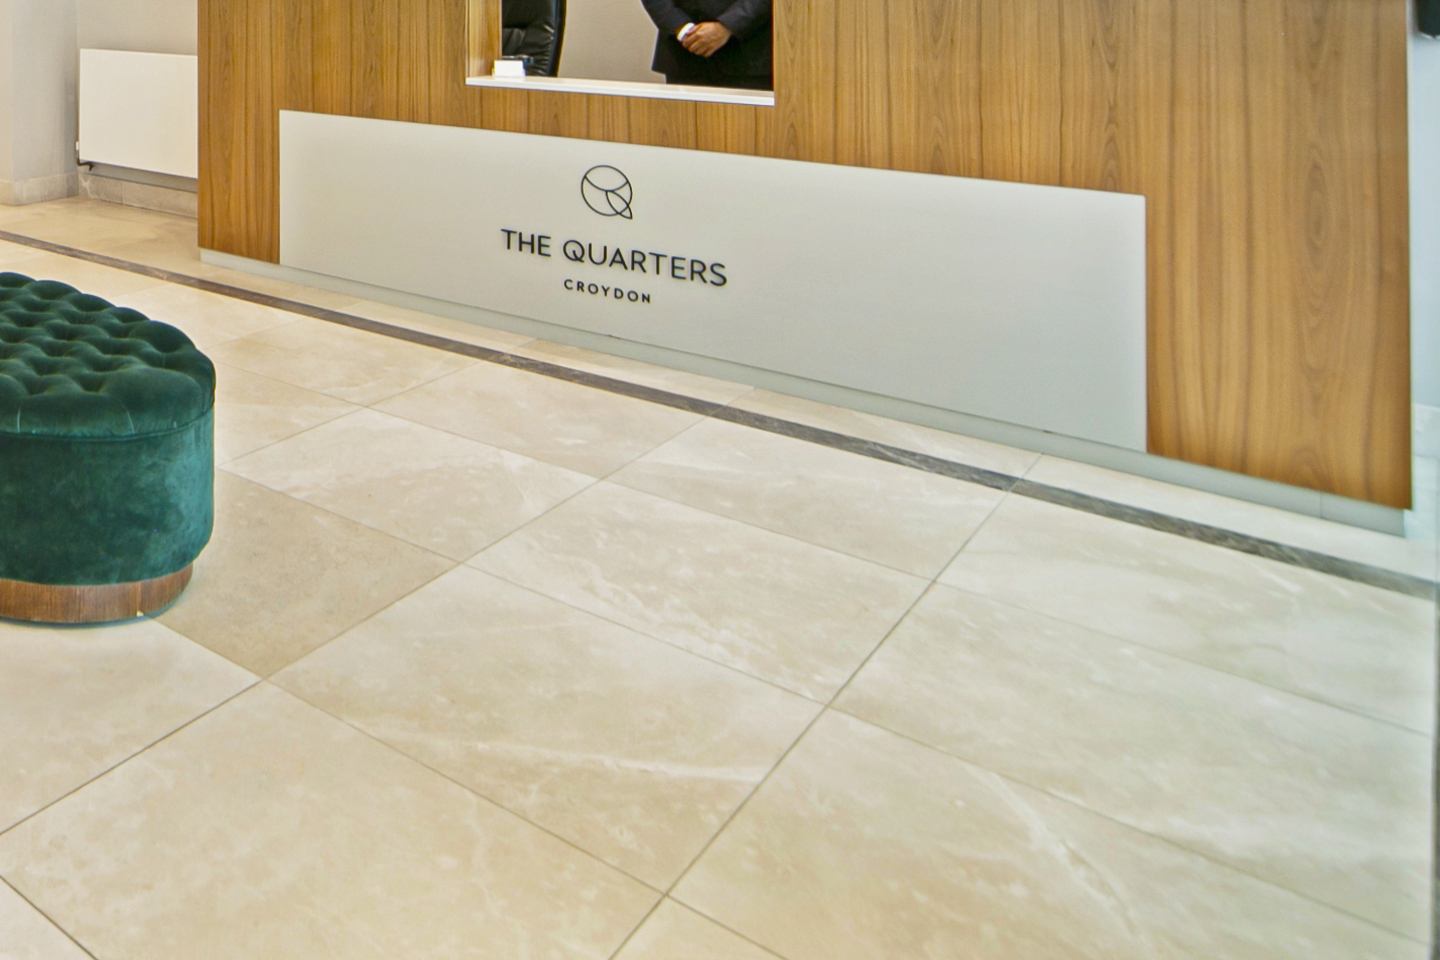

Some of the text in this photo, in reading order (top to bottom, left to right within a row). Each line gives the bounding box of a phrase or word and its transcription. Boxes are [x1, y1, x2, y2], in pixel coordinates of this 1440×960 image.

[500, 228, 728, 287] THE QUARTERS
[563, 278, 652, 304] CROYDON
